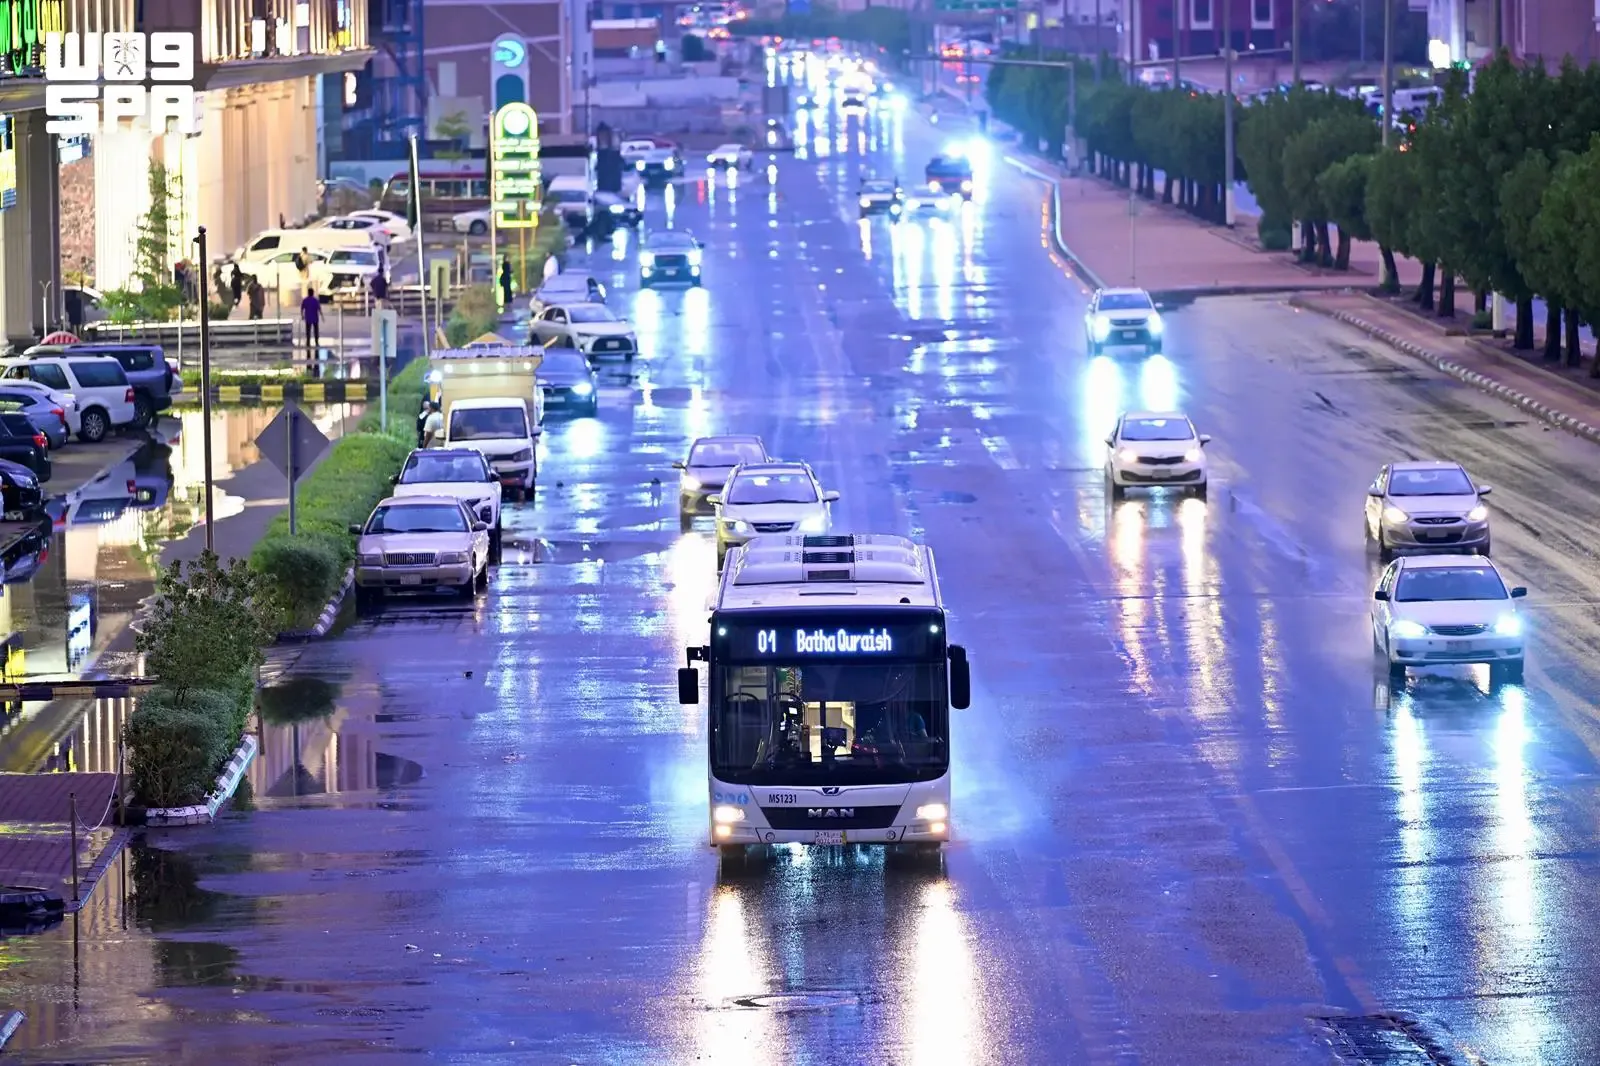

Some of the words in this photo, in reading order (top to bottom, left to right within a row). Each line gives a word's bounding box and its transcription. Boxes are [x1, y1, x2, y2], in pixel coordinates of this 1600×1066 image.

[757, 629, 776, 653] 01
[768, 793, 798, 804] MS1231
[807, 808, 855, 818] MAN
